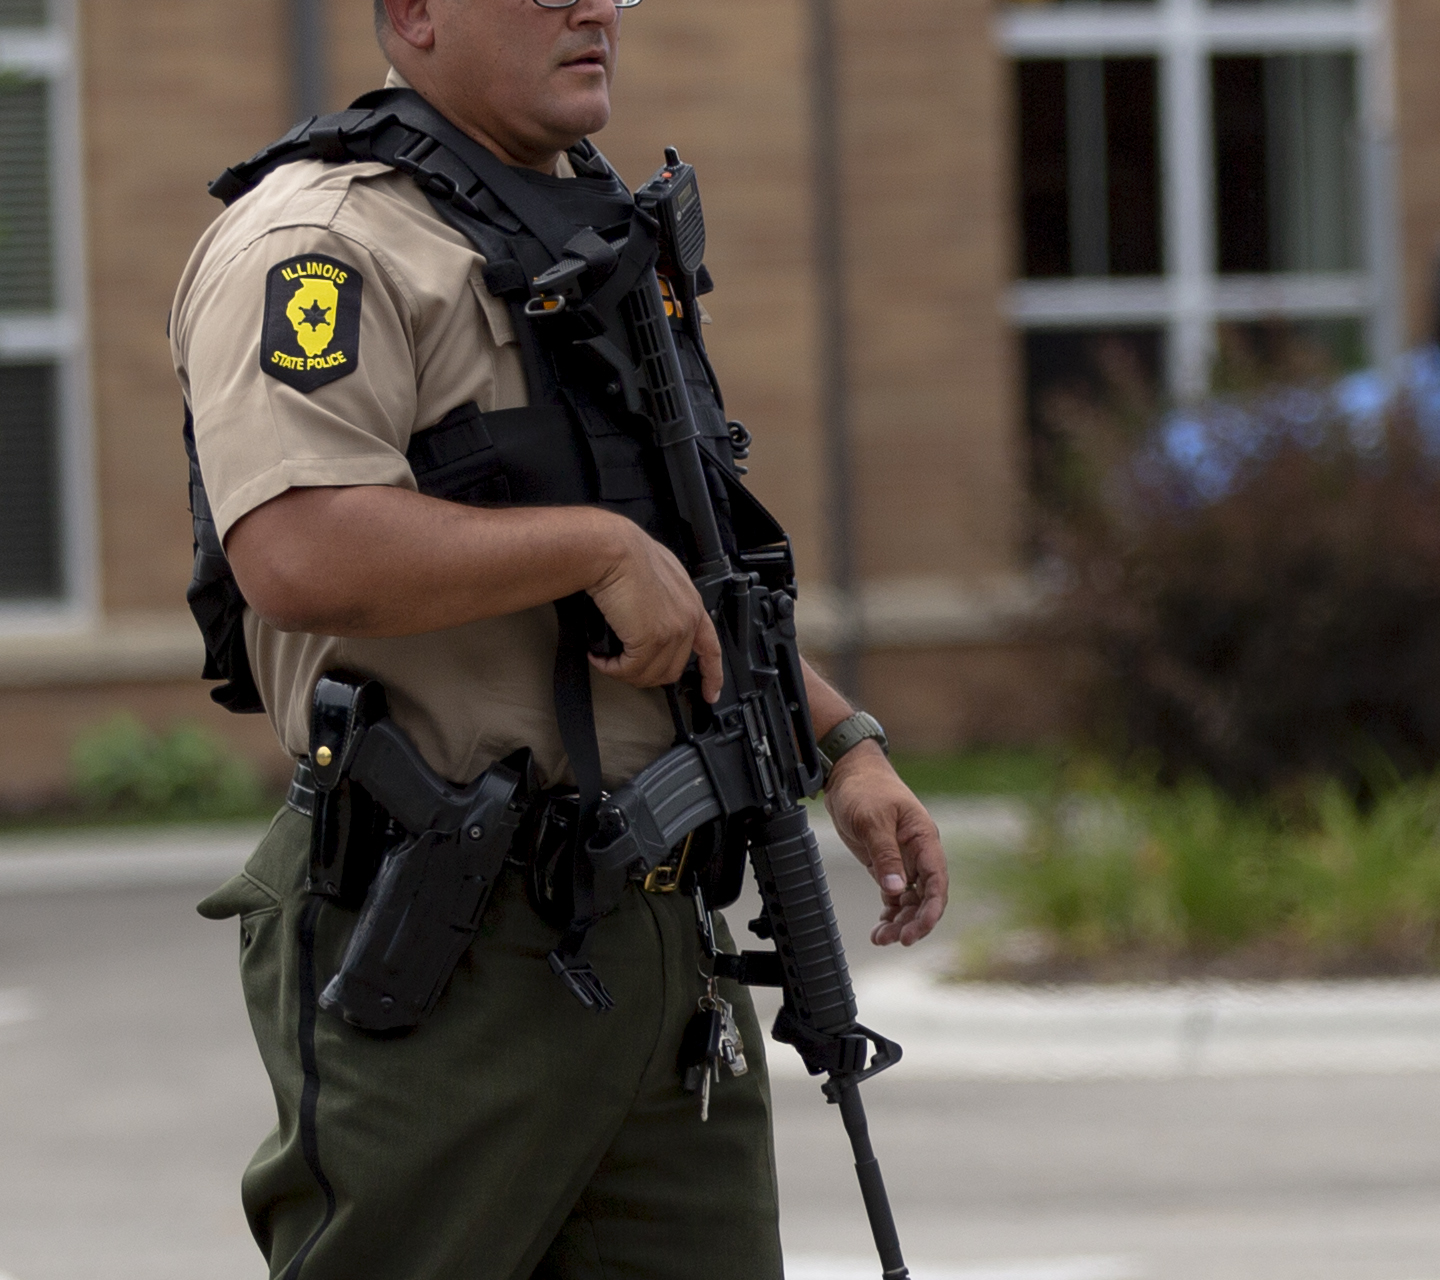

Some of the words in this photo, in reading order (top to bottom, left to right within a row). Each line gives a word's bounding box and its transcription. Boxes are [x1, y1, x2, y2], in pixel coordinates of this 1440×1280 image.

[281, 261, 348, 284] ILLINOIS
[271, 350, 304, 370] STATE
[306, 350, 347, 370] POLICE
